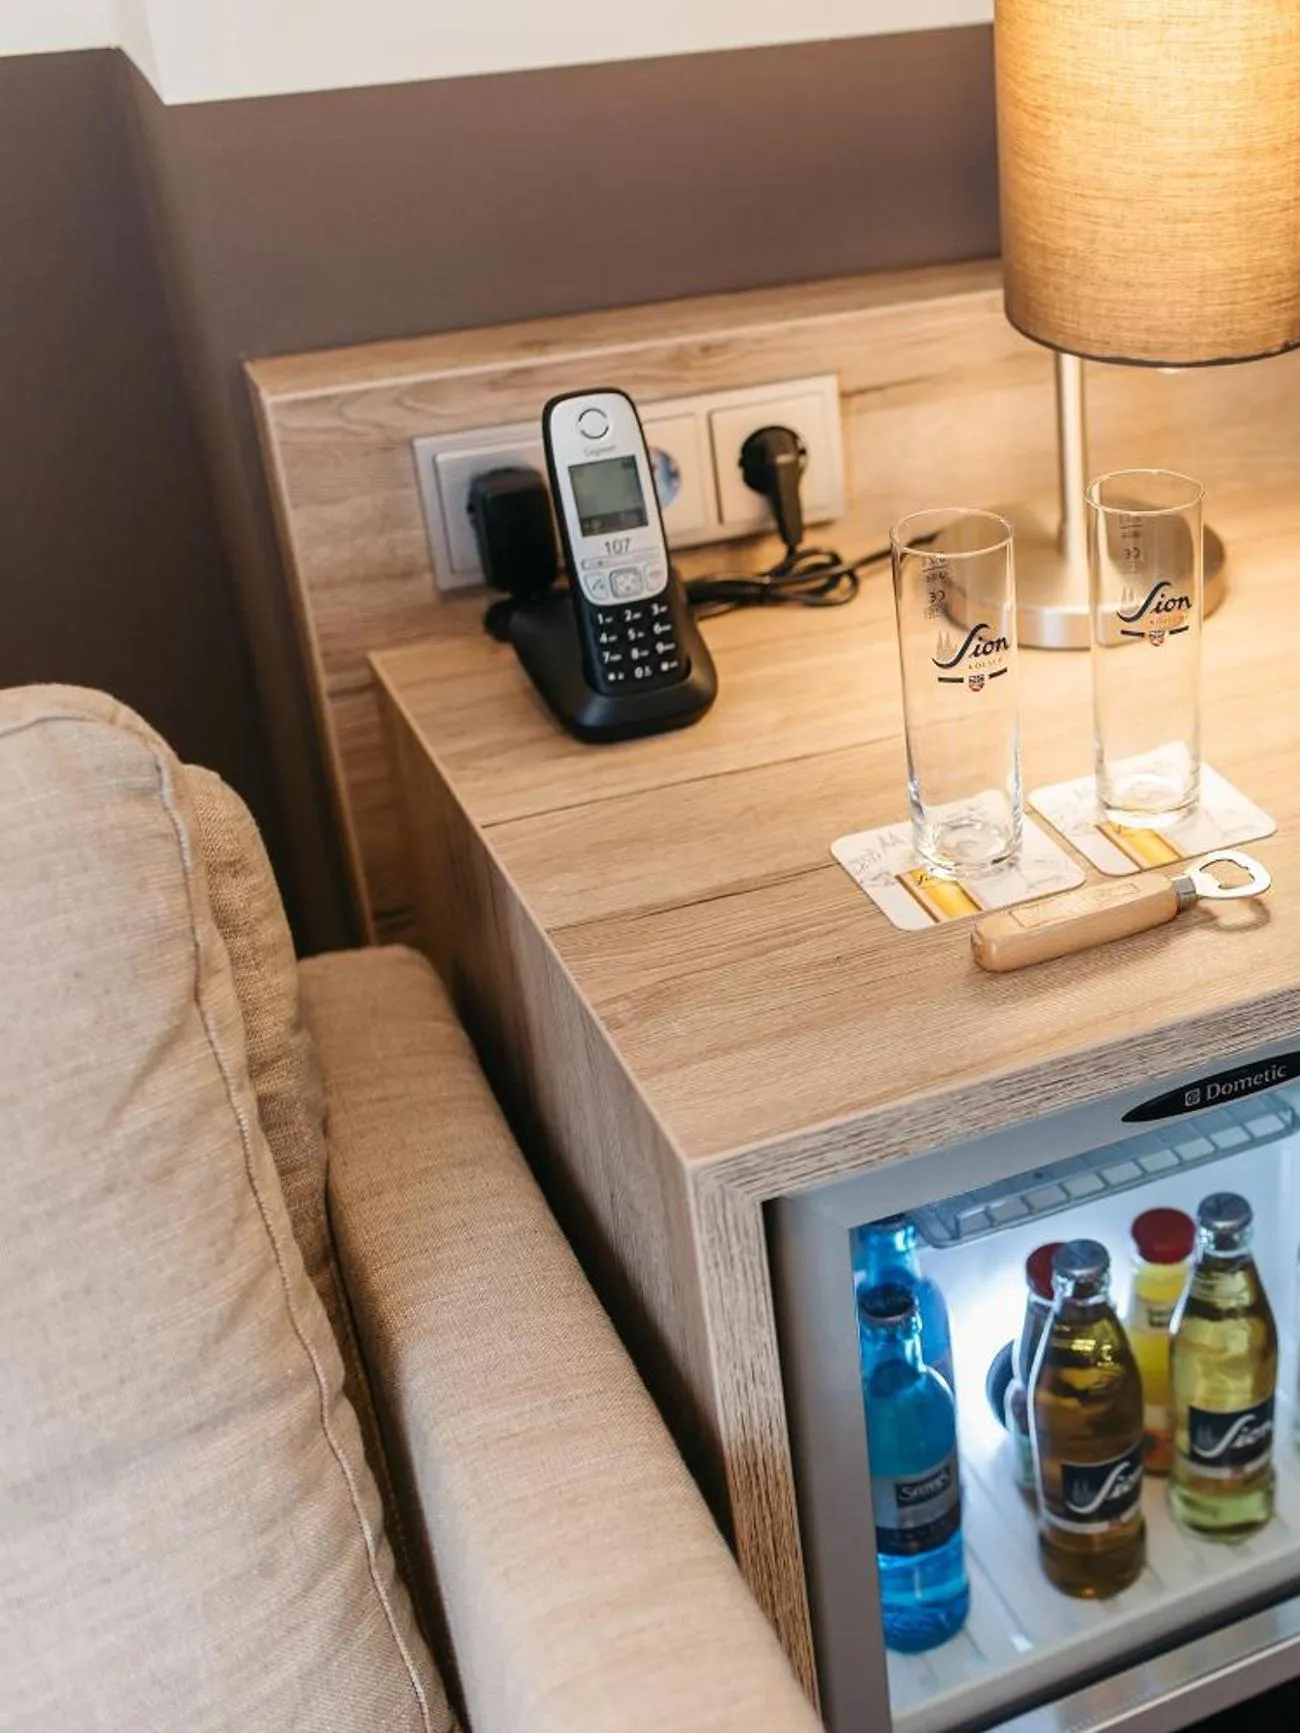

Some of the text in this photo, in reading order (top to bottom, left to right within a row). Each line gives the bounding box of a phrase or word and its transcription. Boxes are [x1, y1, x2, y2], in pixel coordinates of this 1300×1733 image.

[604, 538, 631, 555] 107
[1116, 581, 1192, 622] Sion
[932, 623, 1009, 669] Sion
[1206, 1064, 1288, 1100] Dometic
